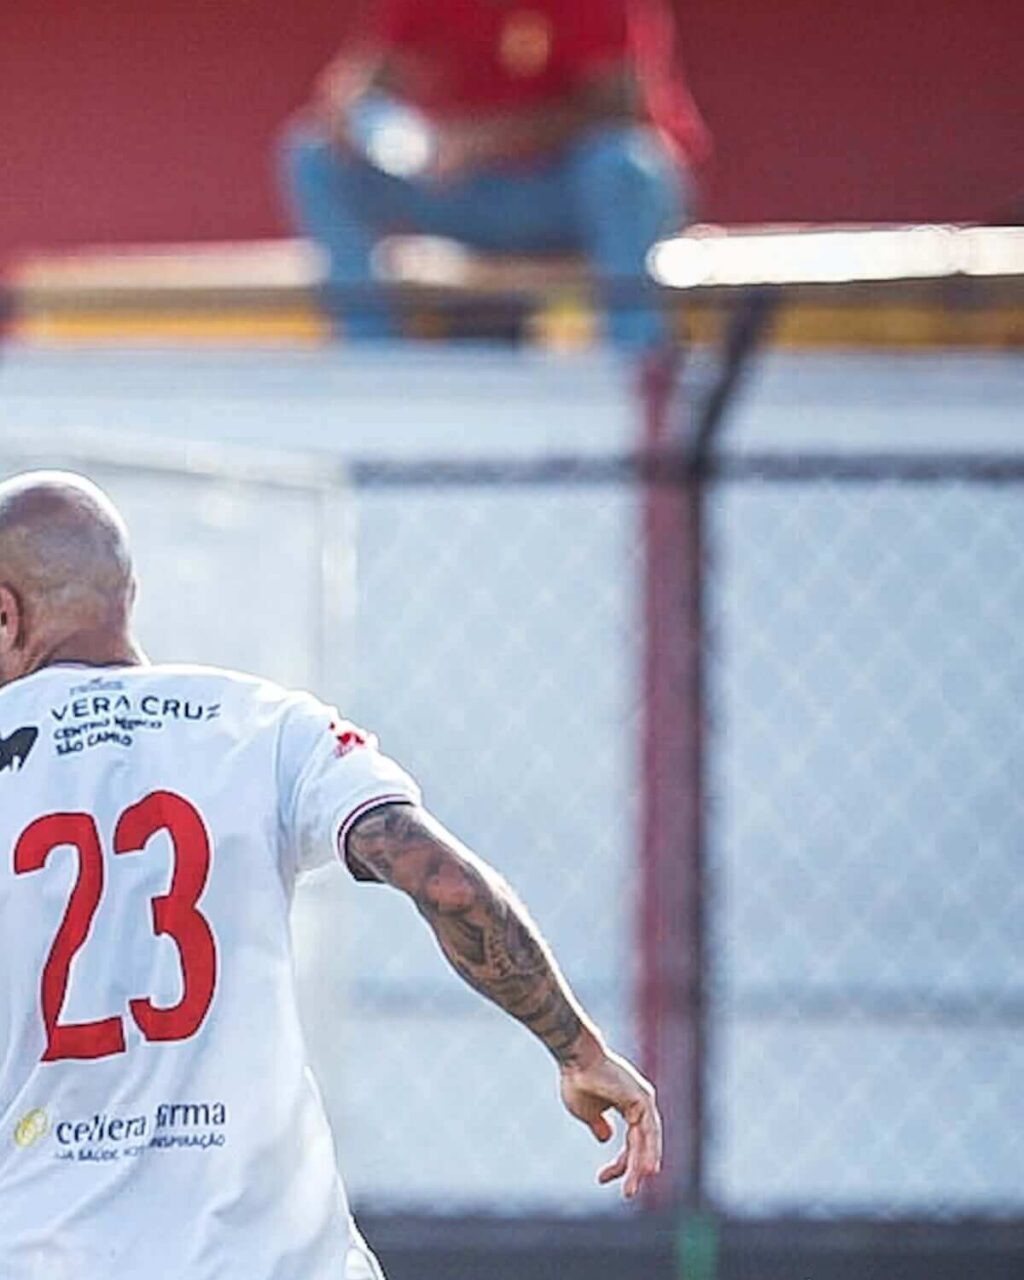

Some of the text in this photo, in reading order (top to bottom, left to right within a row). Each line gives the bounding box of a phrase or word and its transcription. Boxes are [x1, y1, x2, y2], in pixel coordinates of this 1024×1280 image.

[51, 695, 222, 722] VERA CRUZ
[14, 789, 217, 1062] 23
